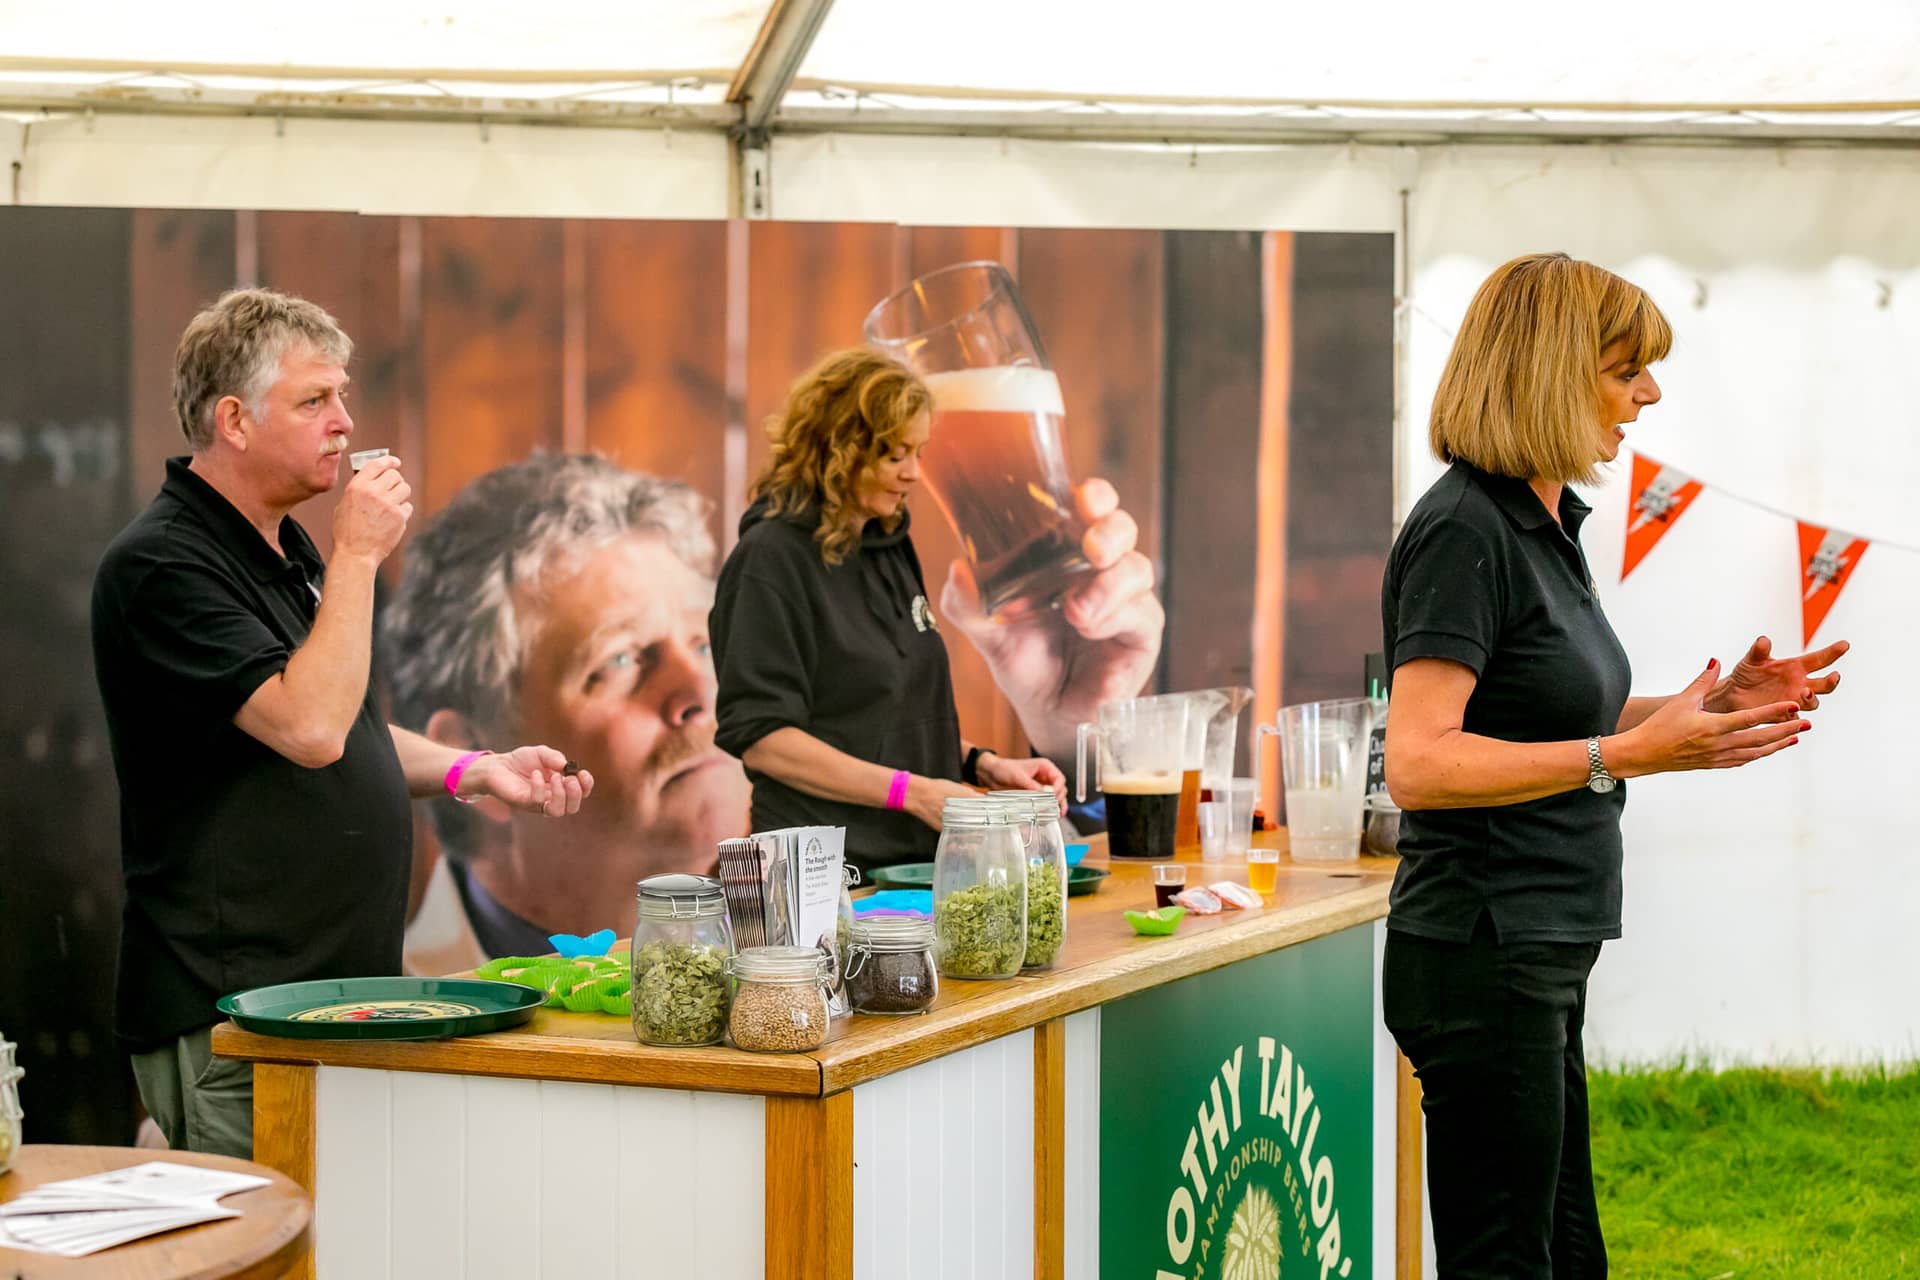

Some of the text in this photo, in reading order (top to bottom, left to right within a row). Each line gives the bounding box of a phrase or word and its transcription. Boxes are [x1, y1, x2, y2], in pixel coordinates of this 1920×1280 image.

[1155, 1044, 1244, 1280] OTHY
[1193, 1137, 1311, 1280] HAMPIONSHIP BEERS
